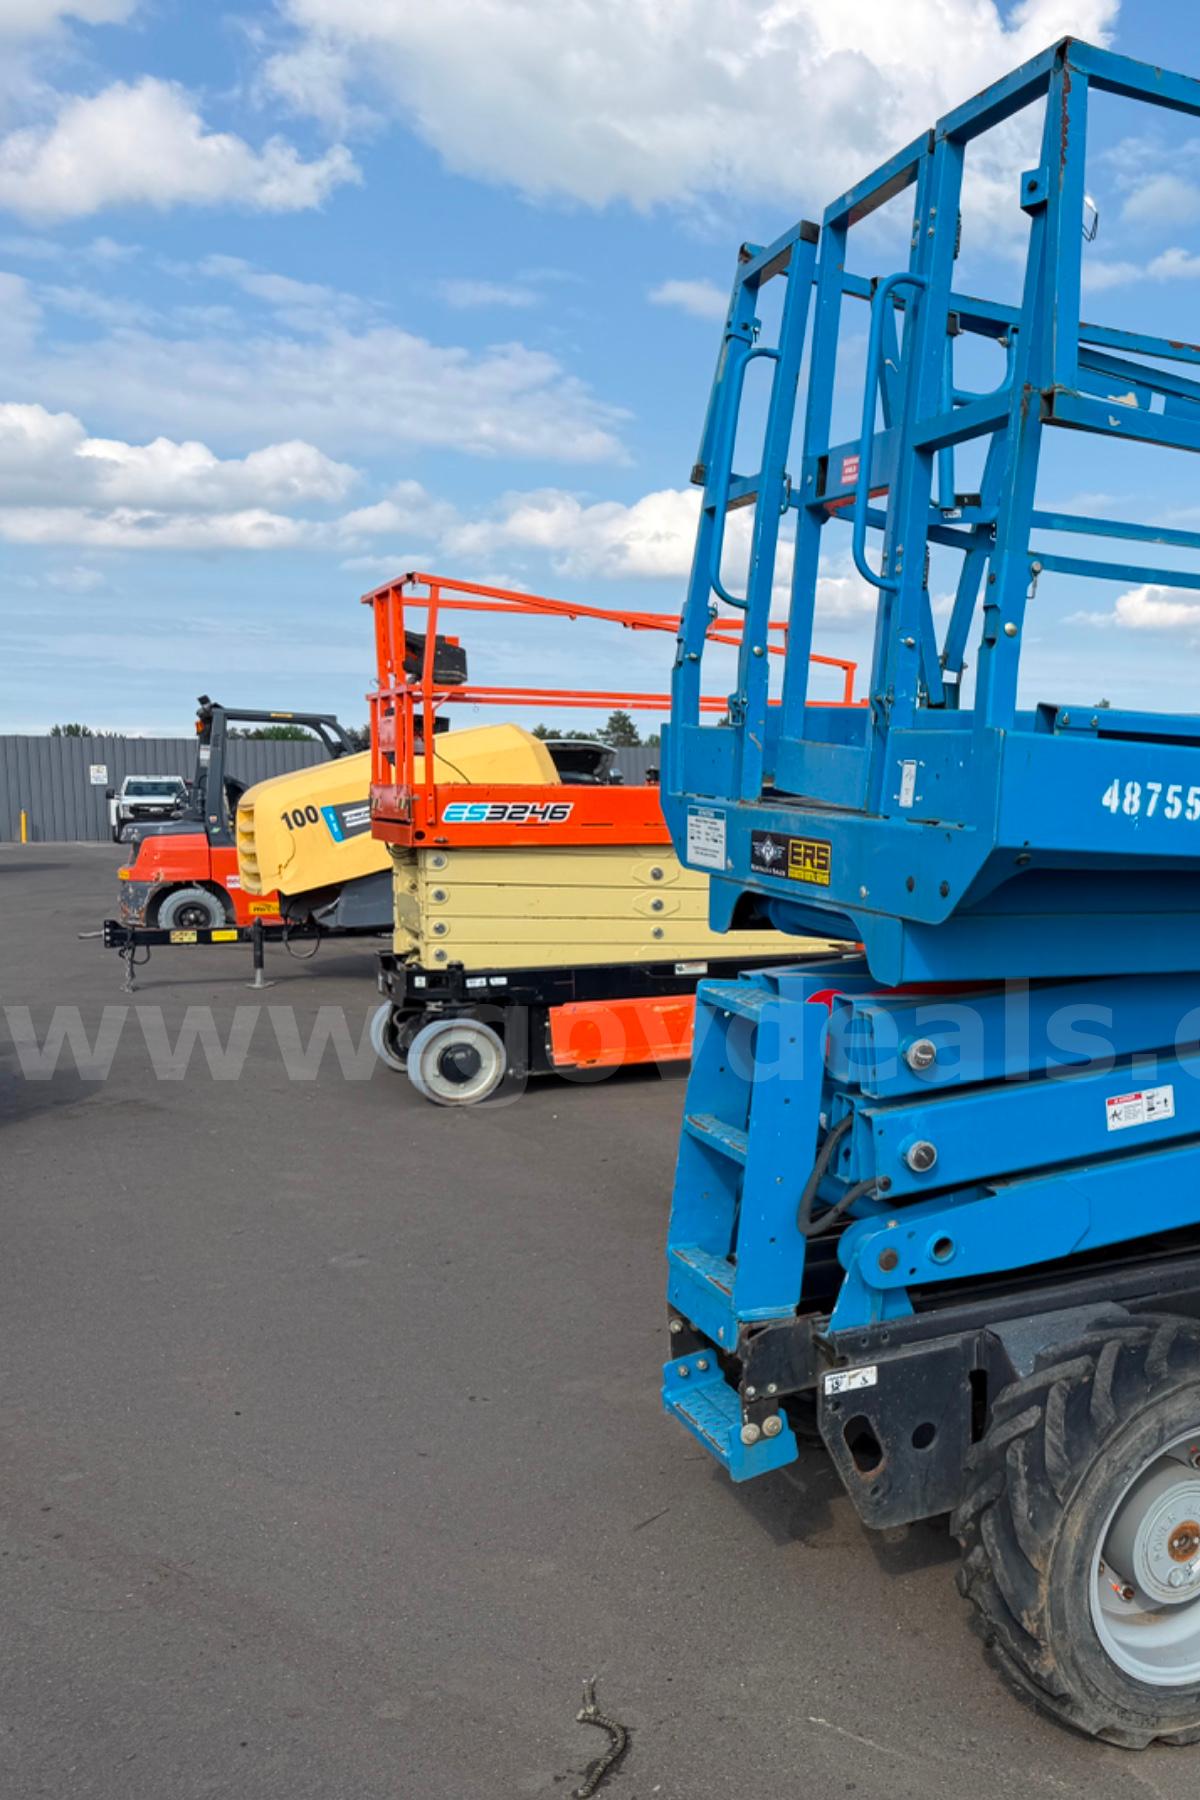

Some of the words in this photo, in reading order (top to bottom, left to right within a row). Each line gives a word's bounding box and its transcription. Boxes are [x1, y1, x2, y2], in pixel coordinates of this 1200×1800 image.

[281, 805, 319, 831] 100
[443, 802, 573, 823] ES3246
[790, 841, 830, 873] ERS
